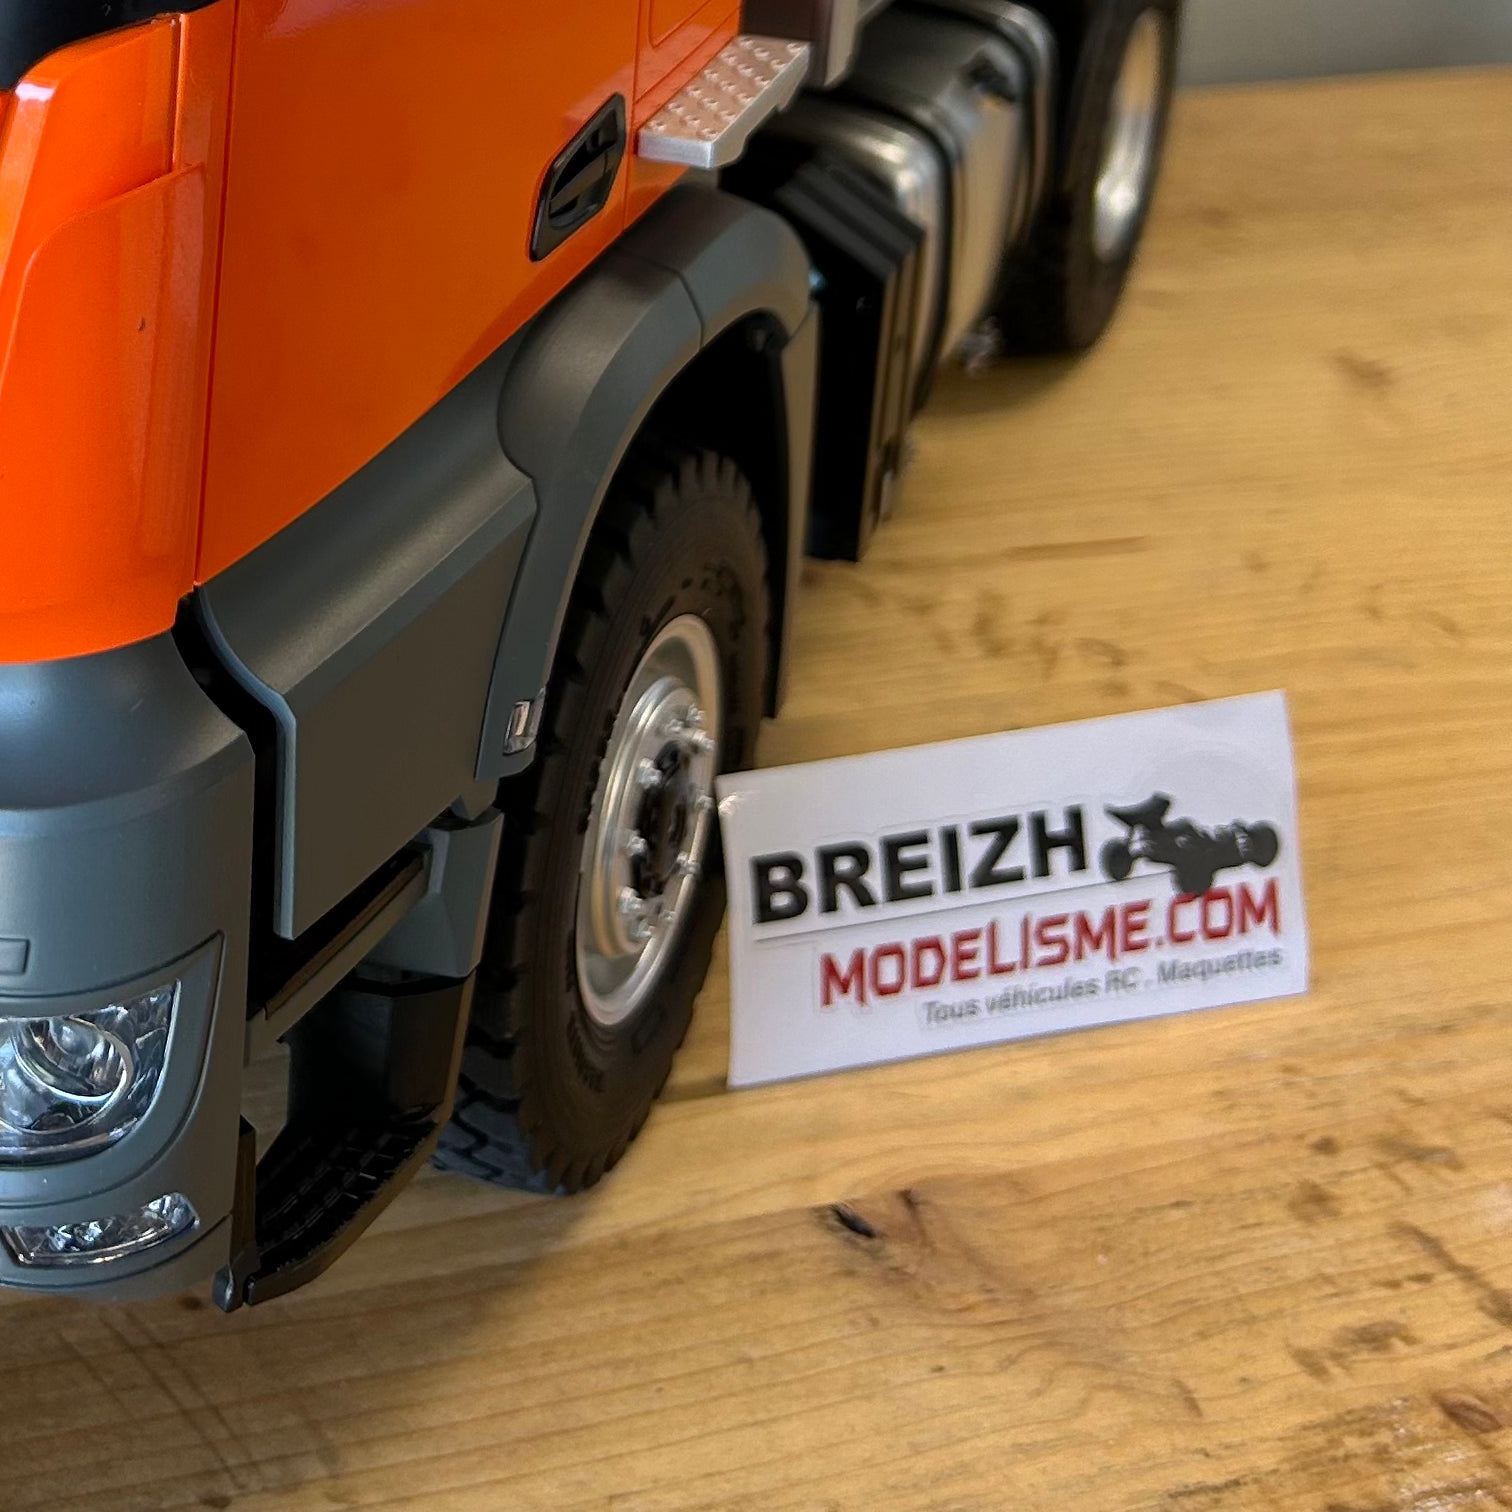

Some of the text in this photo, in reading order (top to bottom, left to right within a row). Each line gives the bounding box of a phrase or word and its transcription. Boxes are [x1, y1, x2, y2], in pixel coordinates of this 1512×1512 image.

[749, 803, 1089, 925] BREIZH
[820, 878, 1281, 1006] MODELISME.COM
[925, 999, 980, 1024] Tous
[1157, 948, 1283, 983] Maquettes
